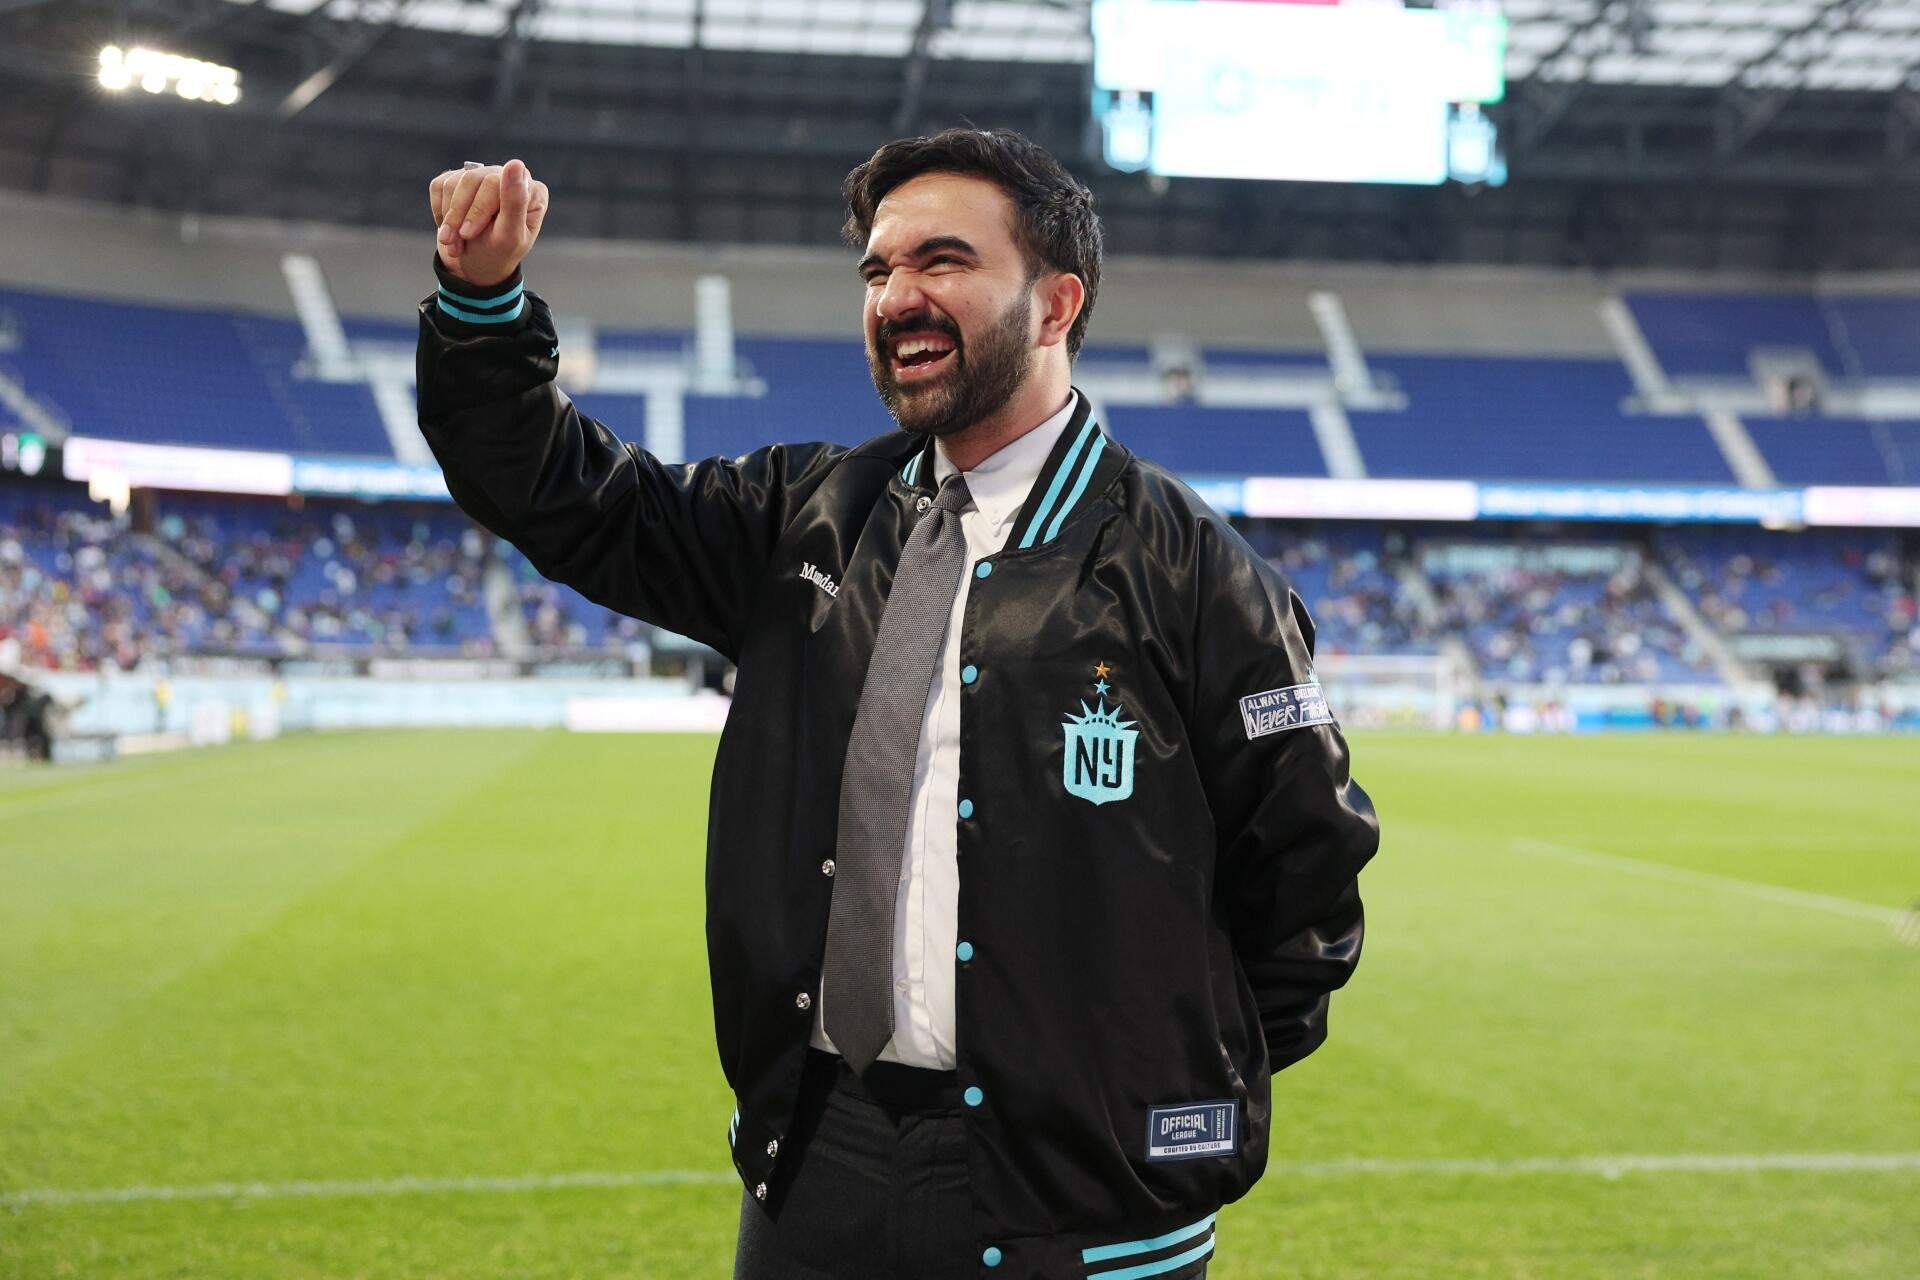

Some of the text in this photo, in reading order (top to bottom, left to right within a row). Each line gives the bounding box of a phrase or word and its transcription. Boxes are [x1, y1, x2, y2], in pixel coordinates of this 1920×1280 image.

[1248, 692, 1289, 711] ALWAYS
[1247, 705, 1297, 736] NEVER
[1074, 735, 1124, 789] NY
[1161, 1113, 1207, 1136] OFFICIAL
[1171, 1129, 1197, 1140] LEAGUE
[1163, 1146, 1188, 1154] CRAFTED
[1198, 1142, 1221, 1151] CULTURE
